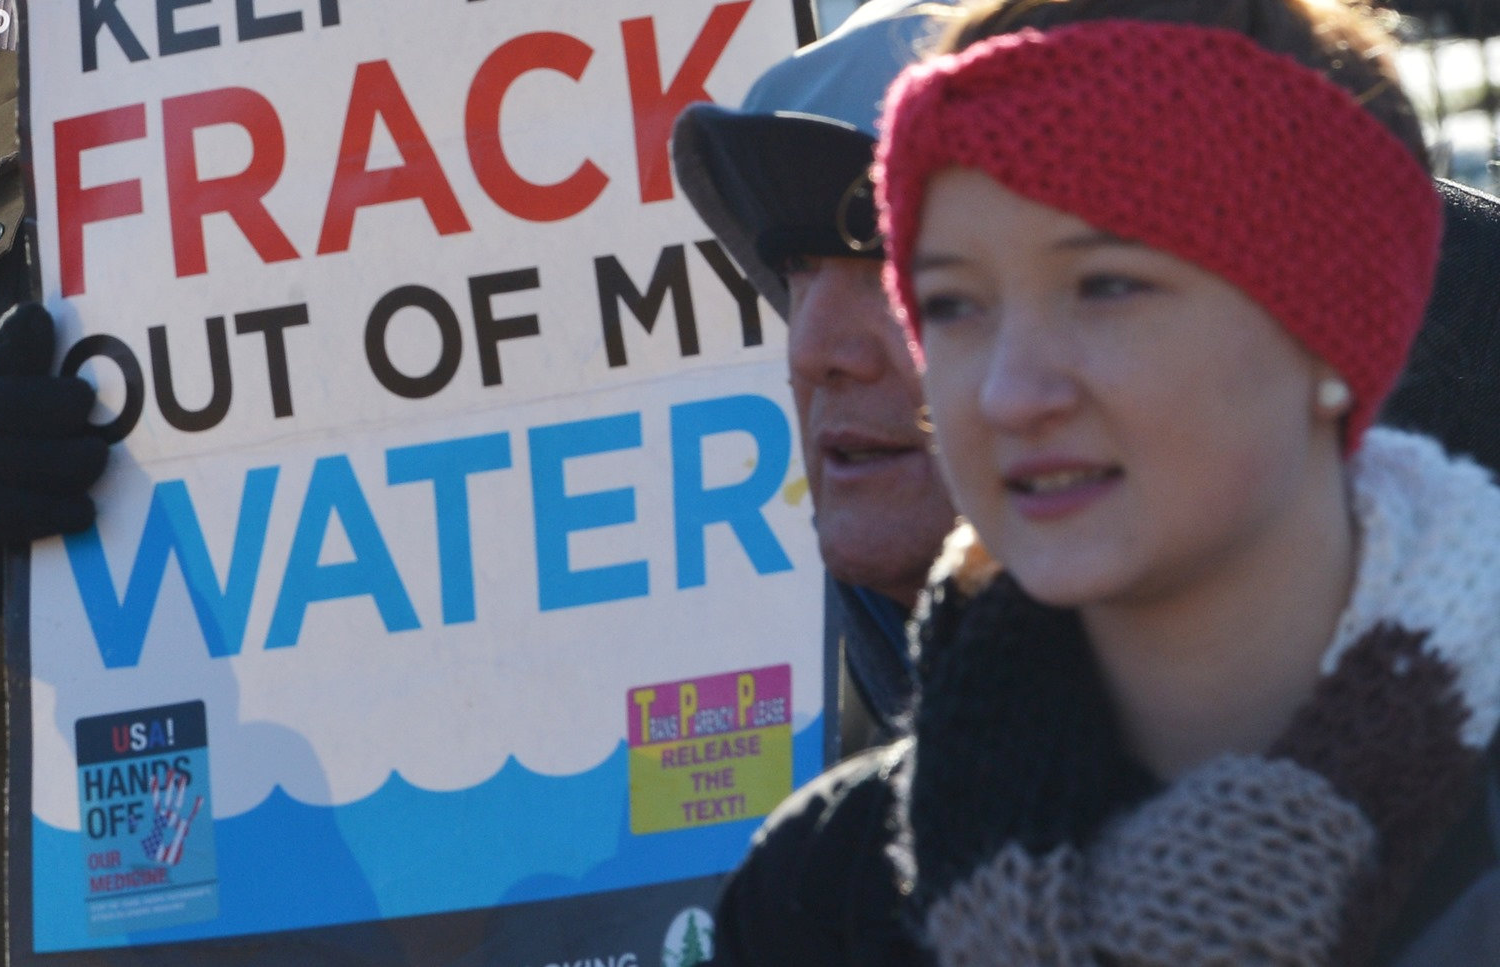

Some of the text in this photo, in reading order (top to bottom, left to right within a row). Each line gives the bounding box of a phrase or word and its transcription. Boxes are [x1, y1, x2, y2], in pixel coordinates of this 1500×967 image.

[60, 239, 763, 446] OUT OF MY
[63, 394, 794, 670] WATER
[112, 717, 175, 753] USA!
[661, 735, 761, 769] RELEASE
[84, 756, 192, 801] HANDS
[691, 767, 736, 792] THE
[87, 801, 145, 840] OFF
[681, 793, 746, 822] TEXT!
